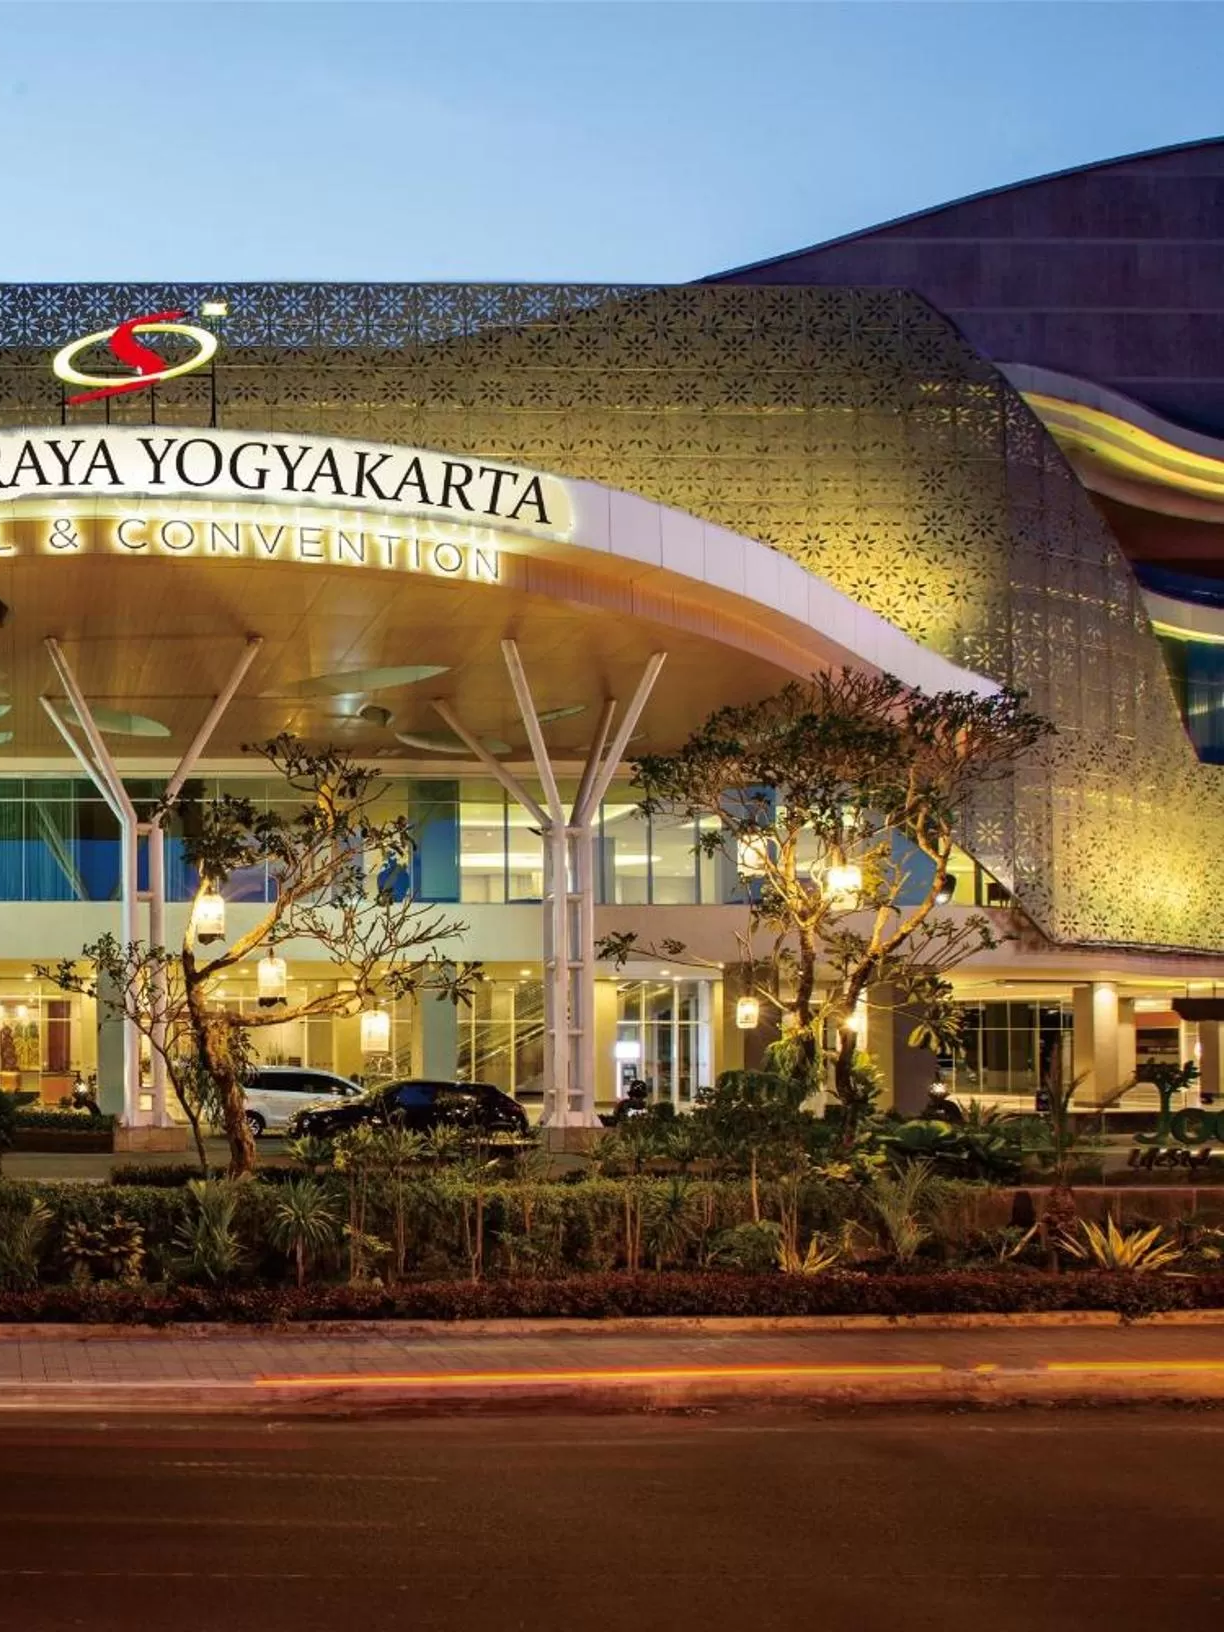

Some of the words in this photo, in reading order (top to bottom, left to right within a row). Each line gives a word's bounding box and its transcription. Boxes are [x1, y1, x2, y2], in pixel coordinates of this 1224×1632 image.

[137, 437, 553, 525] YOGYAKARTA
[48, 517, 80, 550] &
[117, 517, 499, 580] CONVENTION
